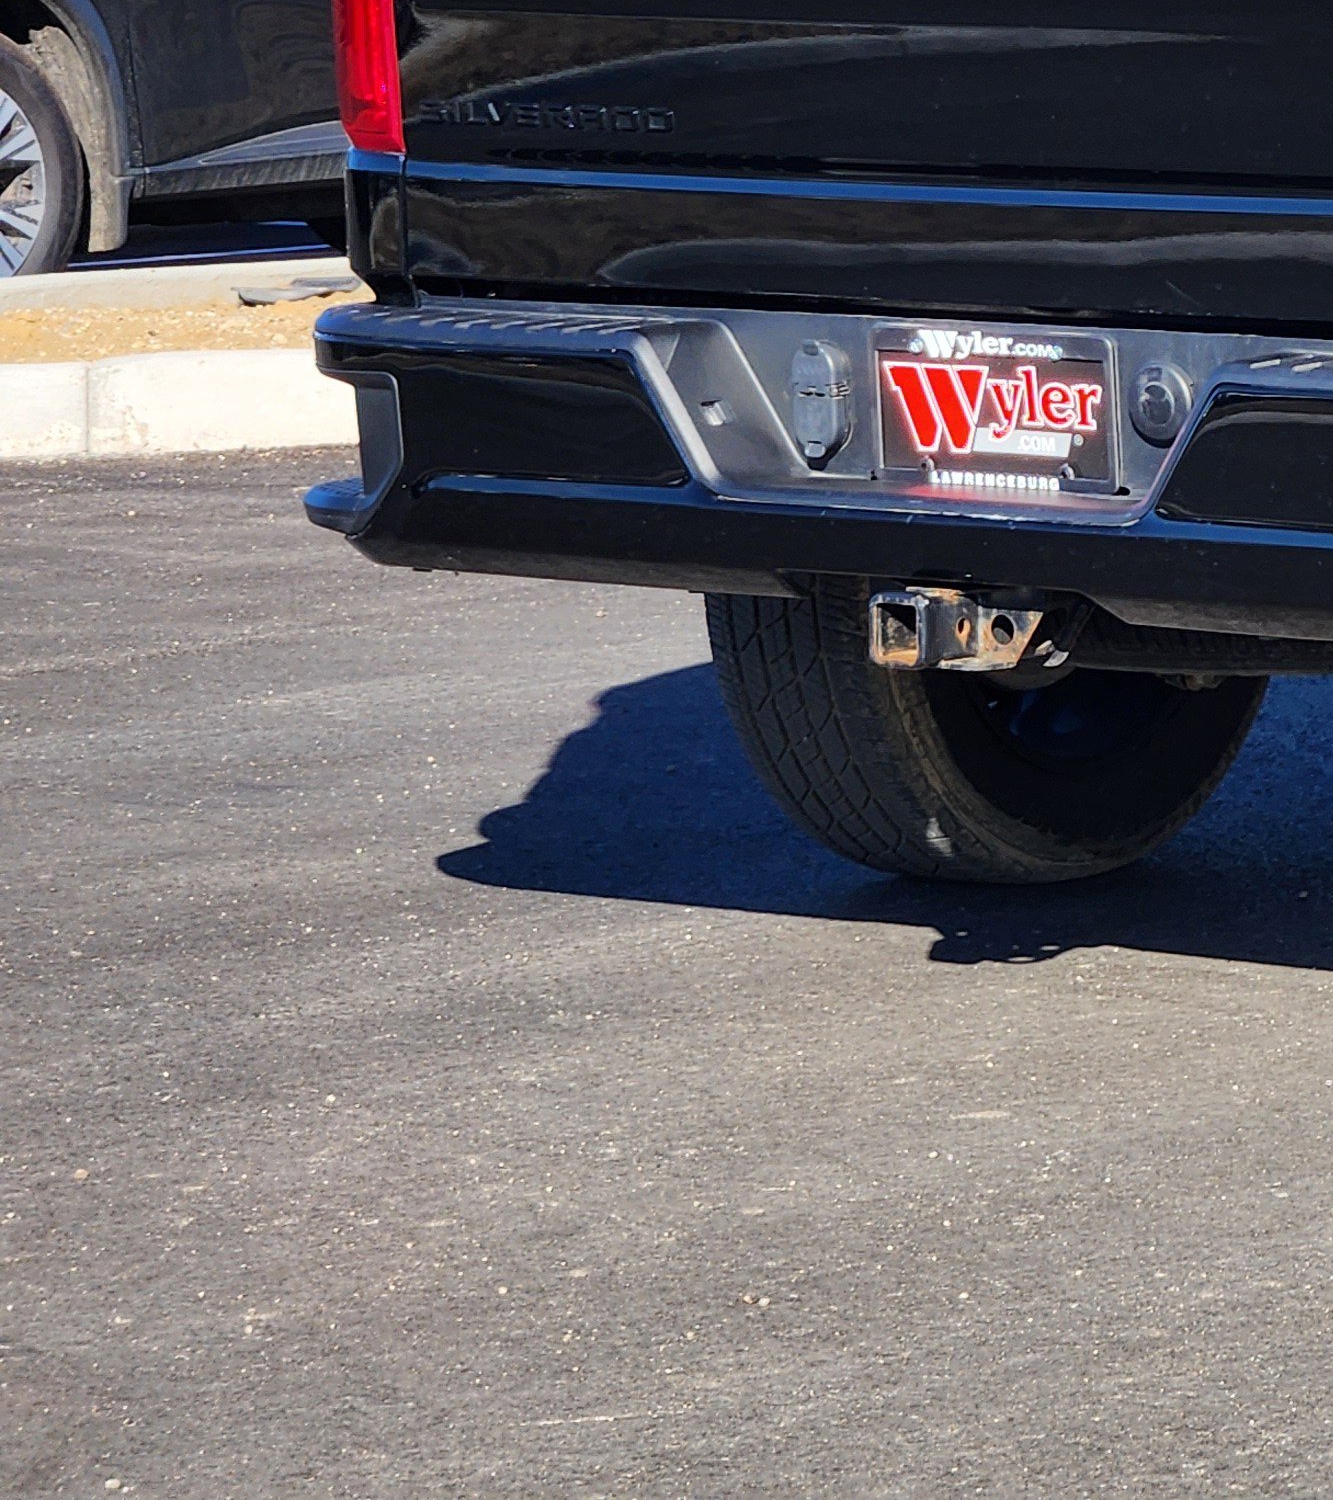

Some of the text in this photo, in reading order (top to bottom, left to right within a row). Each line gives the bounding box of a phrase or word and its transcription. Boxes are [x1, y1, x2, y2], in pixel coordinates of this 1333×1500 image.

[418, 100, 675, 132] SILVERADO
[883, 360, 1103, 454] Wyler
[930, 470, 1060, 491] LAWRENCEBURG
